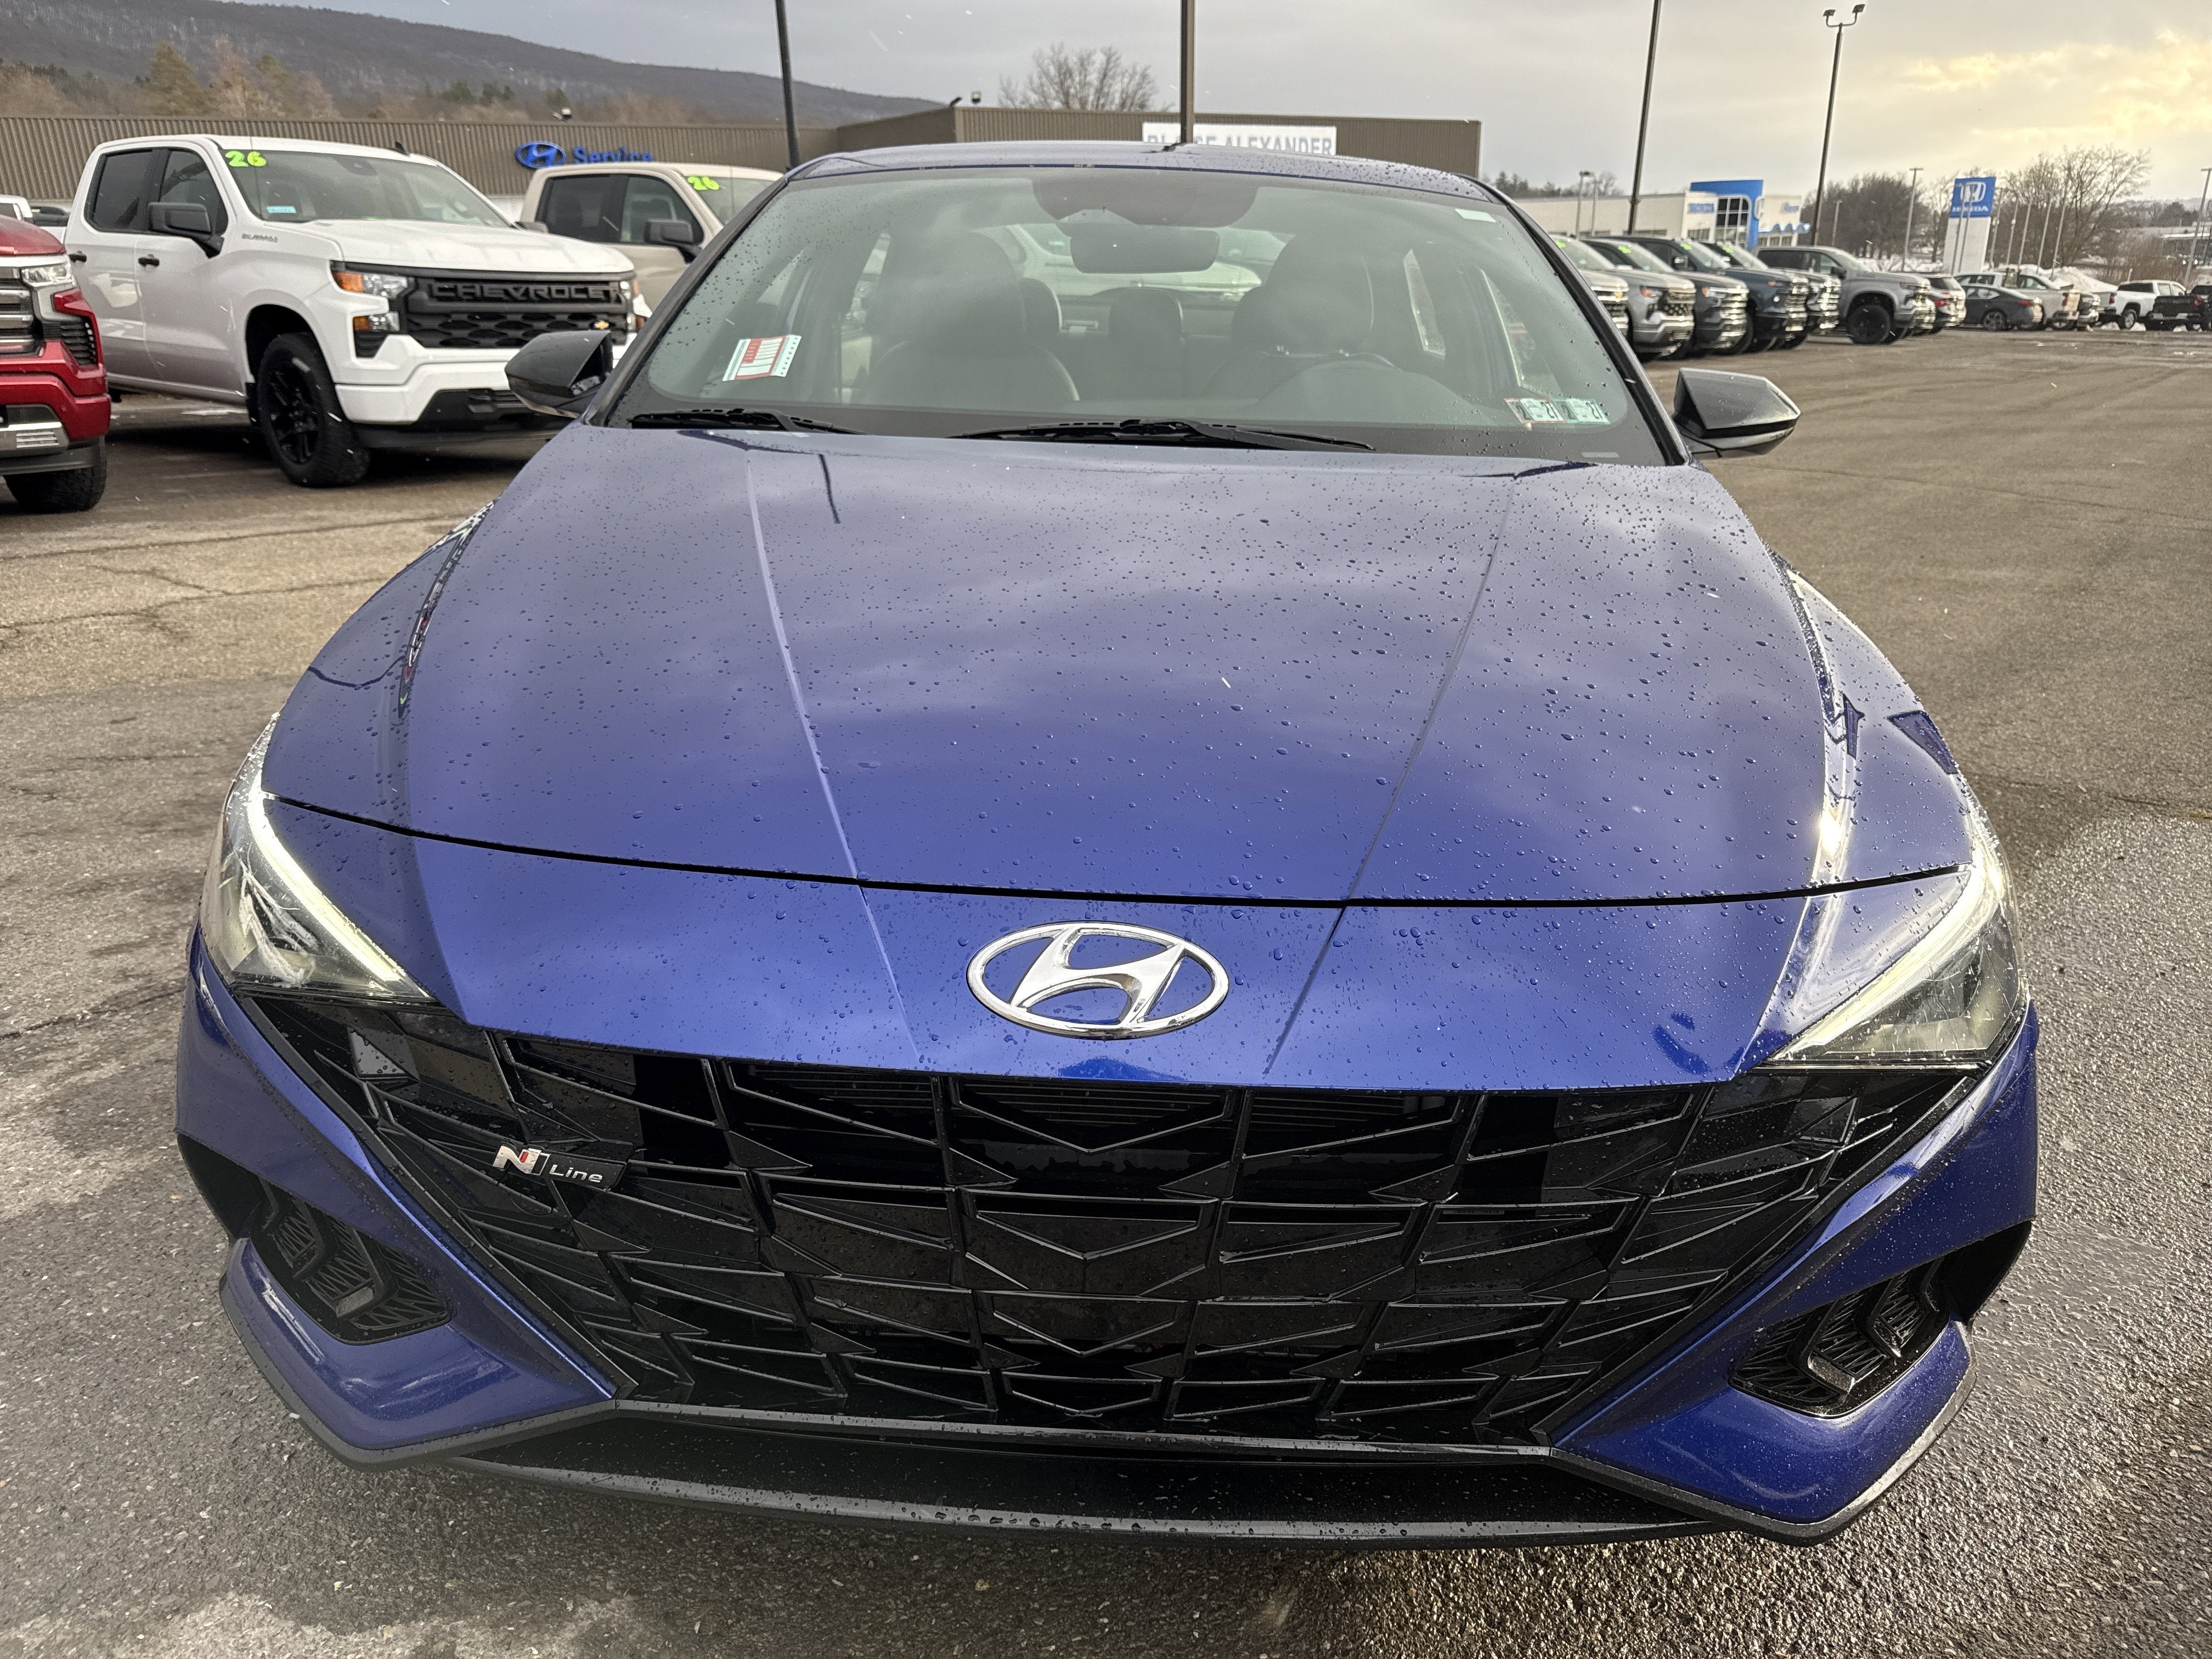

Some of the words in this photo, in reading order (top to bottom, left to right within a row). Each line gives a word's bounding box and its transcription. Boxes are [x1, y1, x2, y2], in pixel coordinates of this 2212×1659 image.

[573, 145, 653, 164] Service
[1225, 136, 1332, 155] ALEXANDER
[225, 150, 267, 167] 26
[687, 176, 720, 190] 26
[549, 1164, 603, 1183] Line
